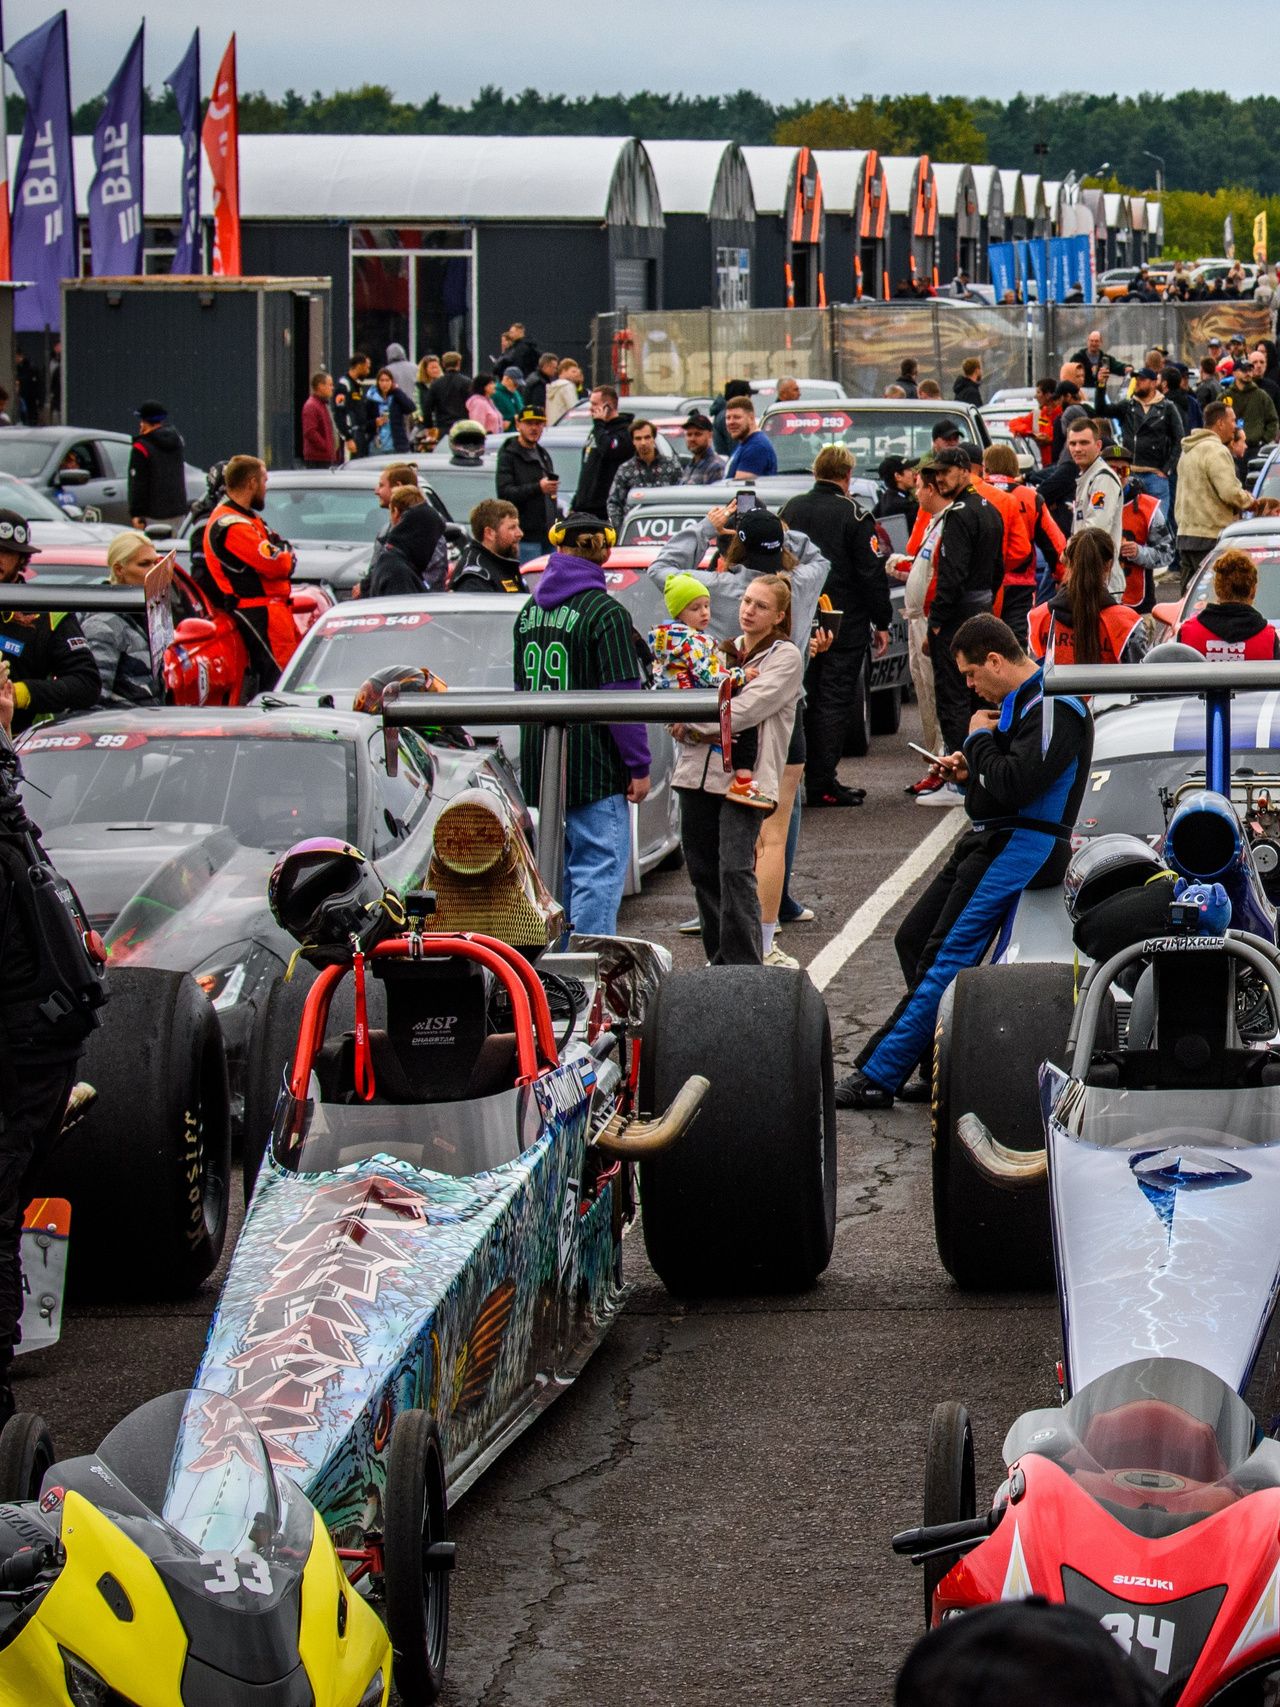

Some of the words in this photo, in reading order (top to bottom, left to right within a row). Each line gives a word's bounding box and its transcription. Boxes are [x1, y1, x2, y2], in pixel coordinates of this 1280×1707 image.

[821, 415, 845, 428] 293
[523, 641, 569, 691] 99
[95, 734, 127, 748] 99
[1090, 769, 1112, 792] 7
[424, 1015, 458, 1031] ISP
[199, 1549, 274, 1596] 33
[1112, 1574, 1174, 1591] SUZUKI
